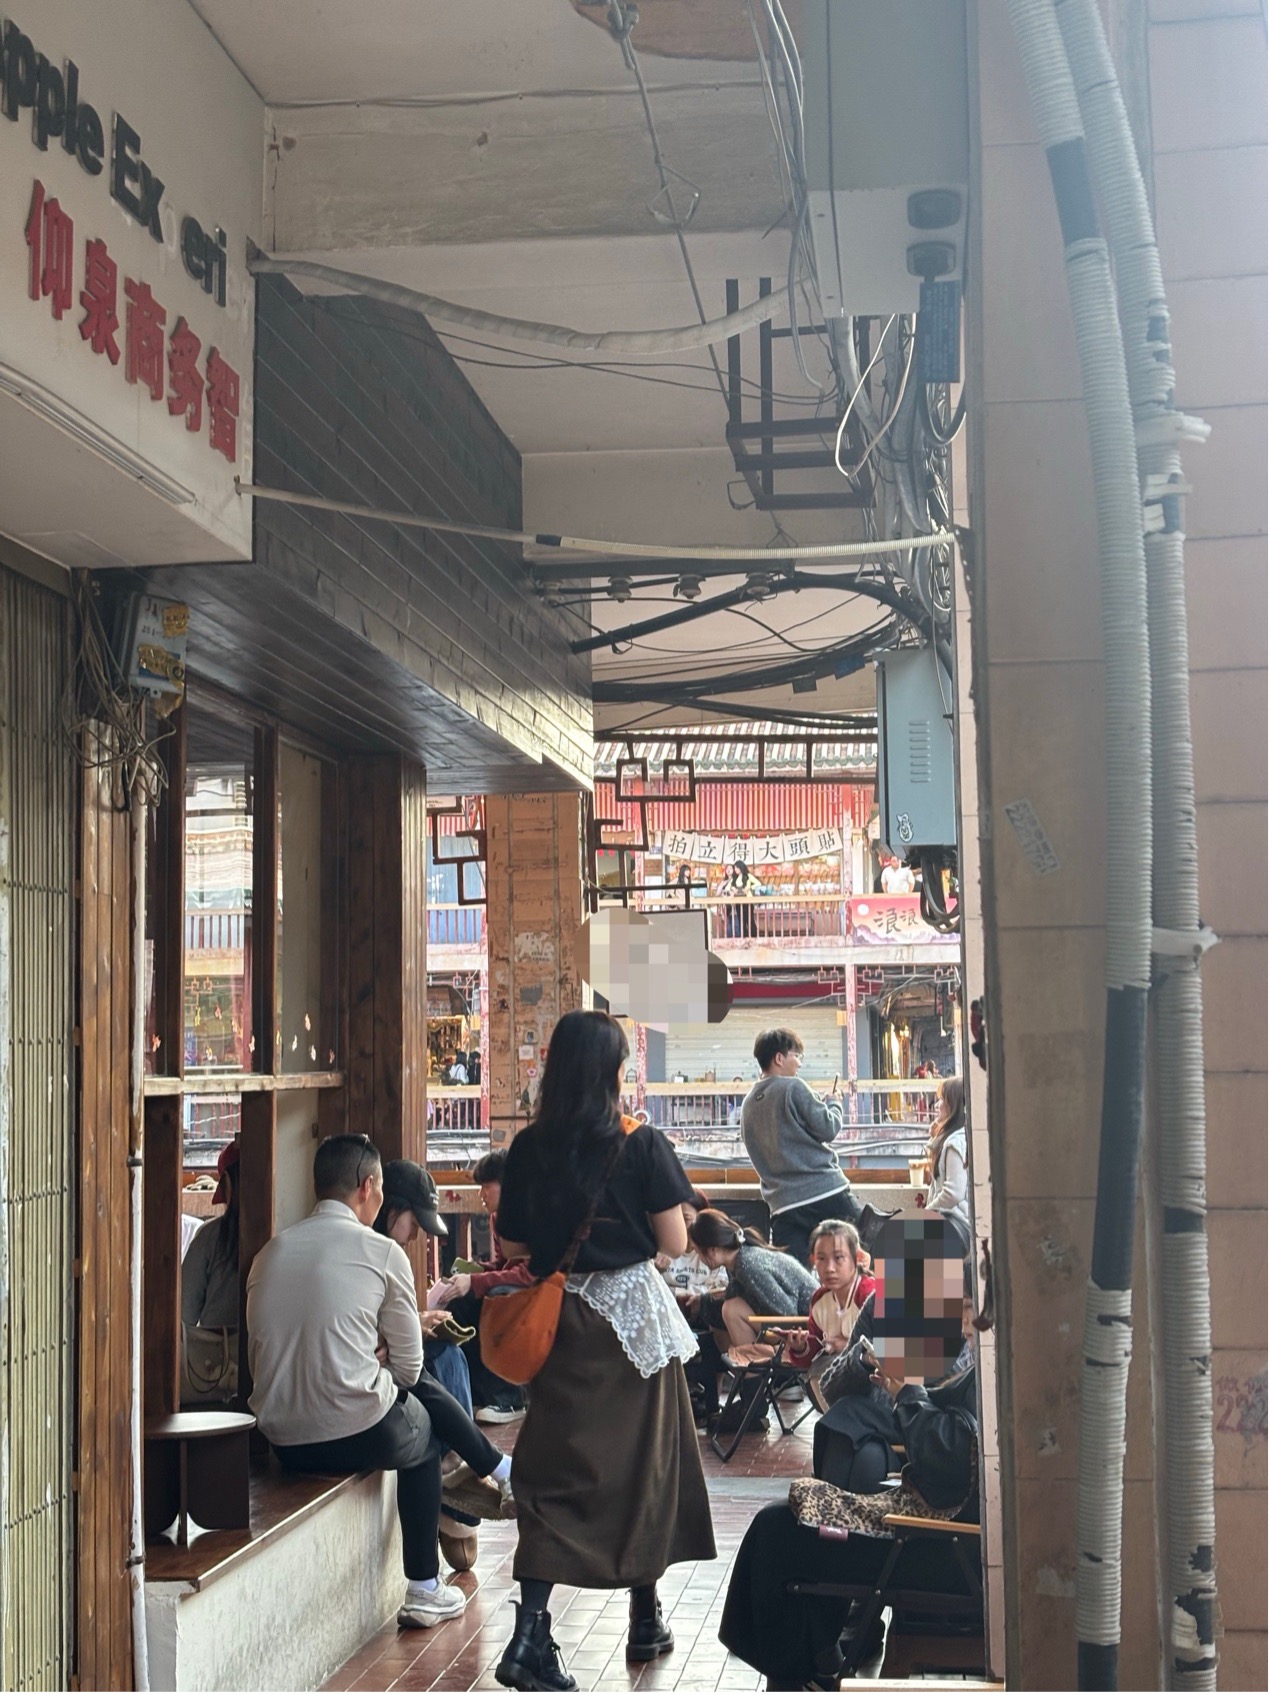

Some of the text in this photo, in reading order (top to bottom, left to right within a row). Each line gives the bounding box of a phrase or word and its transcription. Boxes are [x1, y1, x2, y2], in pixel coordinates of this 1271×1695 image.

[0, 17, 105, 176] pple
[668, 830, 836, 862] 拍立得大頭貼
